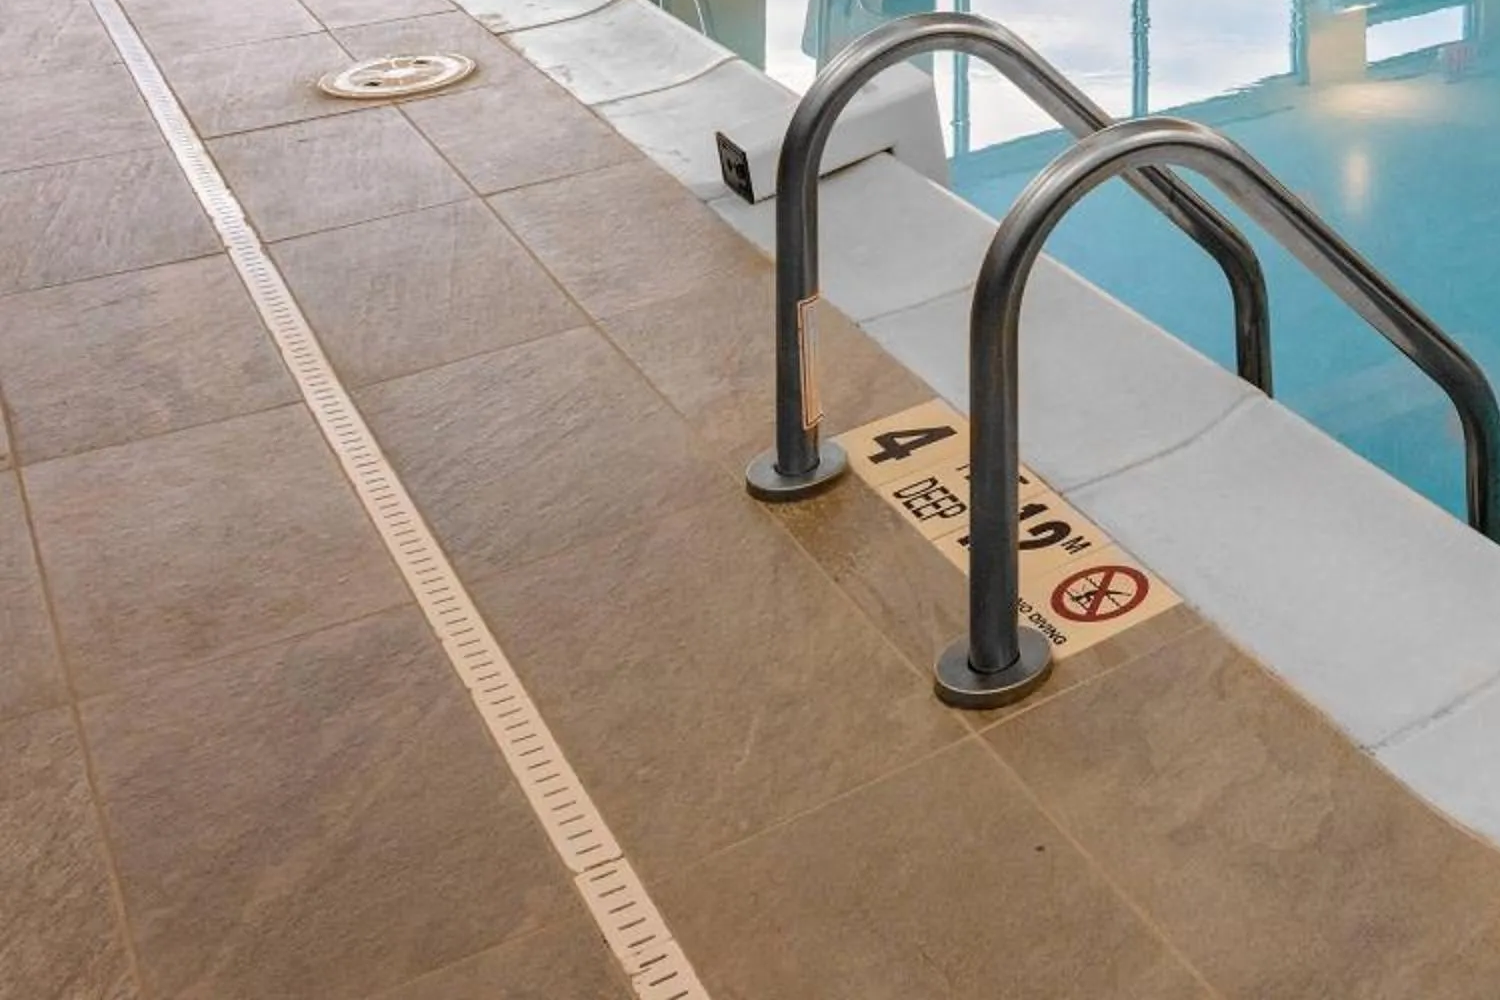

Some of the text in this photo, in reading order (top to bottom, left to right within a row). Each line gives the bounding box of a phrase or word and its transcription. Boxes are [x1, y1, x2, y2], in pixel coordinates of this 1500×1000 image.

[867, 425, 958, 465] 4
[892, 476, 967, 522] DEEP
[1028, 612, 1067, 645] DIVING
